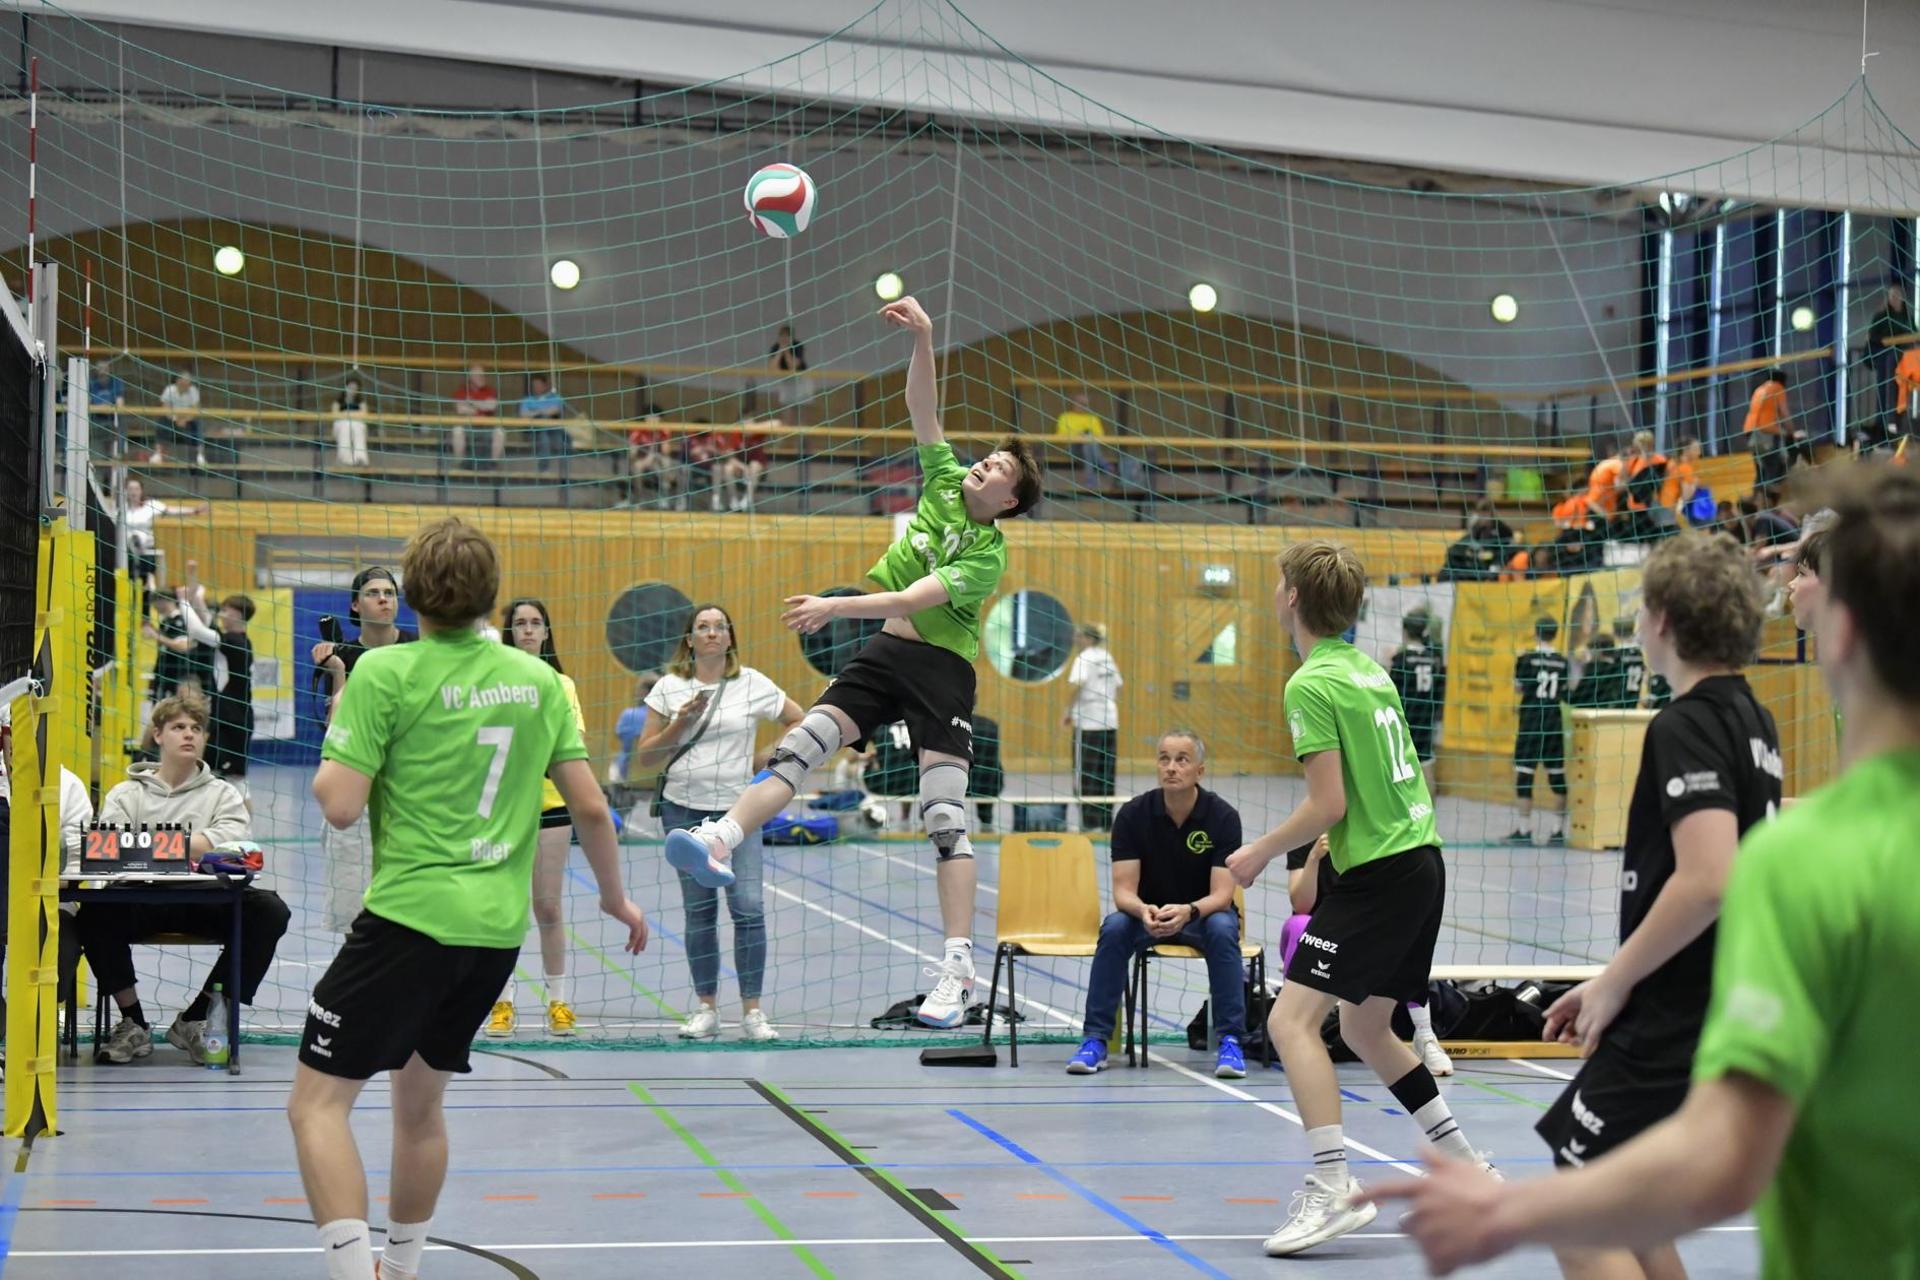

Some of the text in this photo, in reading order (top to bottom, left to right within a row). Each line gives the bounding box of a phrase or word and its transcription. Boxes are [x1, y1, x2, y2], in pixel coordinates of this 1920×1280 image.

[441, 681, 539, 709] VC Amberg
[1535, 670, 1559, 699] 21
[1374, 706, 1416, 783] 12
[477, 727, 514, 819] 7
[86, 831, 186, 859] 24 0 0 24
